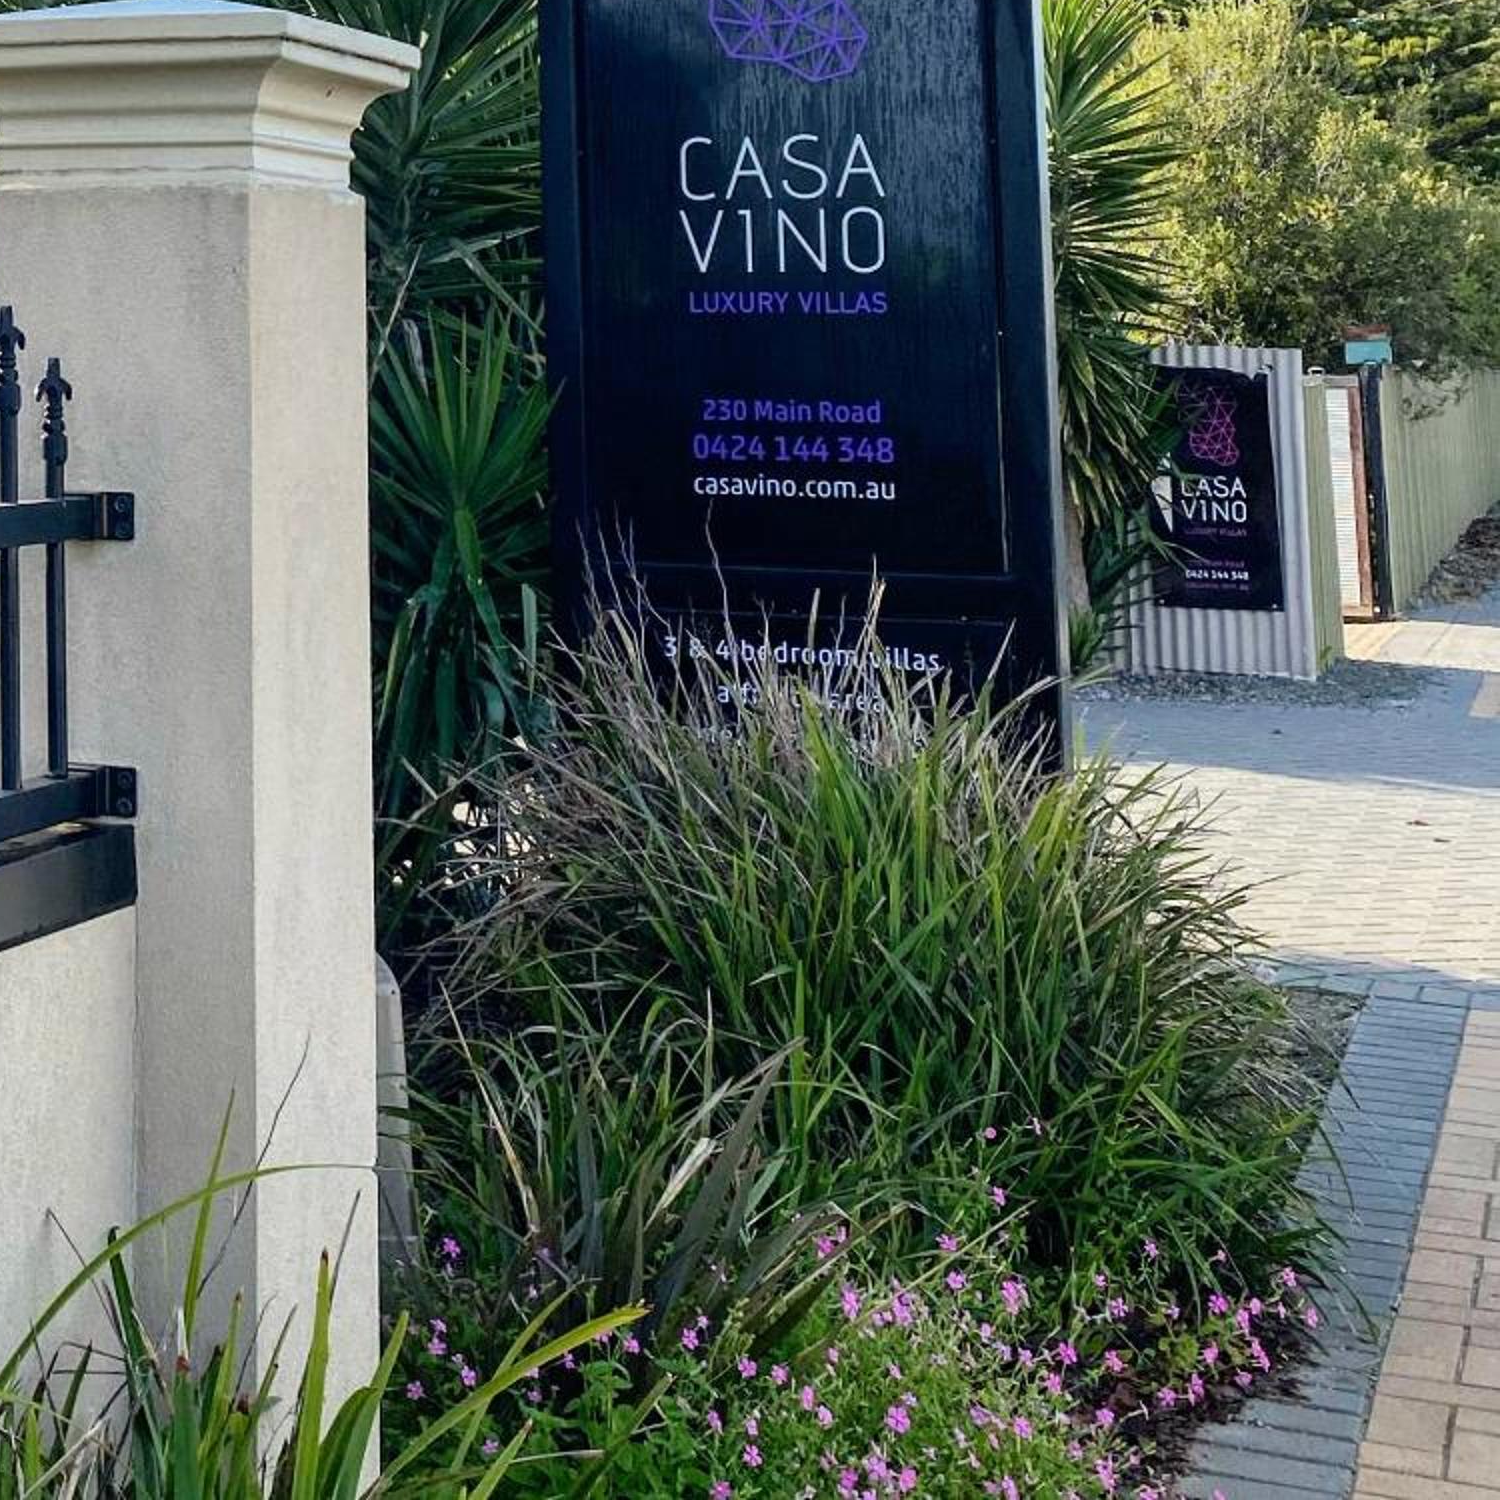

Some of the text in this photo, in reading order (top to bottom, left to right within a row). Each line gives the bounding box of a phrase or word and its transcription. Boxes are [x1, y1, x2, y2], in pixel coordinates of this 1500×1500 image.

[679, 133, 886, 201] CASA
[688, 291, 889, 315] LUXURY VILLAS
[702, 398, 882, 424] 230 Main Road
[693, 433, 895, 464] 0424 144 348
[693, 472, 897, 501] casavino.com.au
[664, 635, 677, 657] 3
[715, 639, 731, 660] 4
